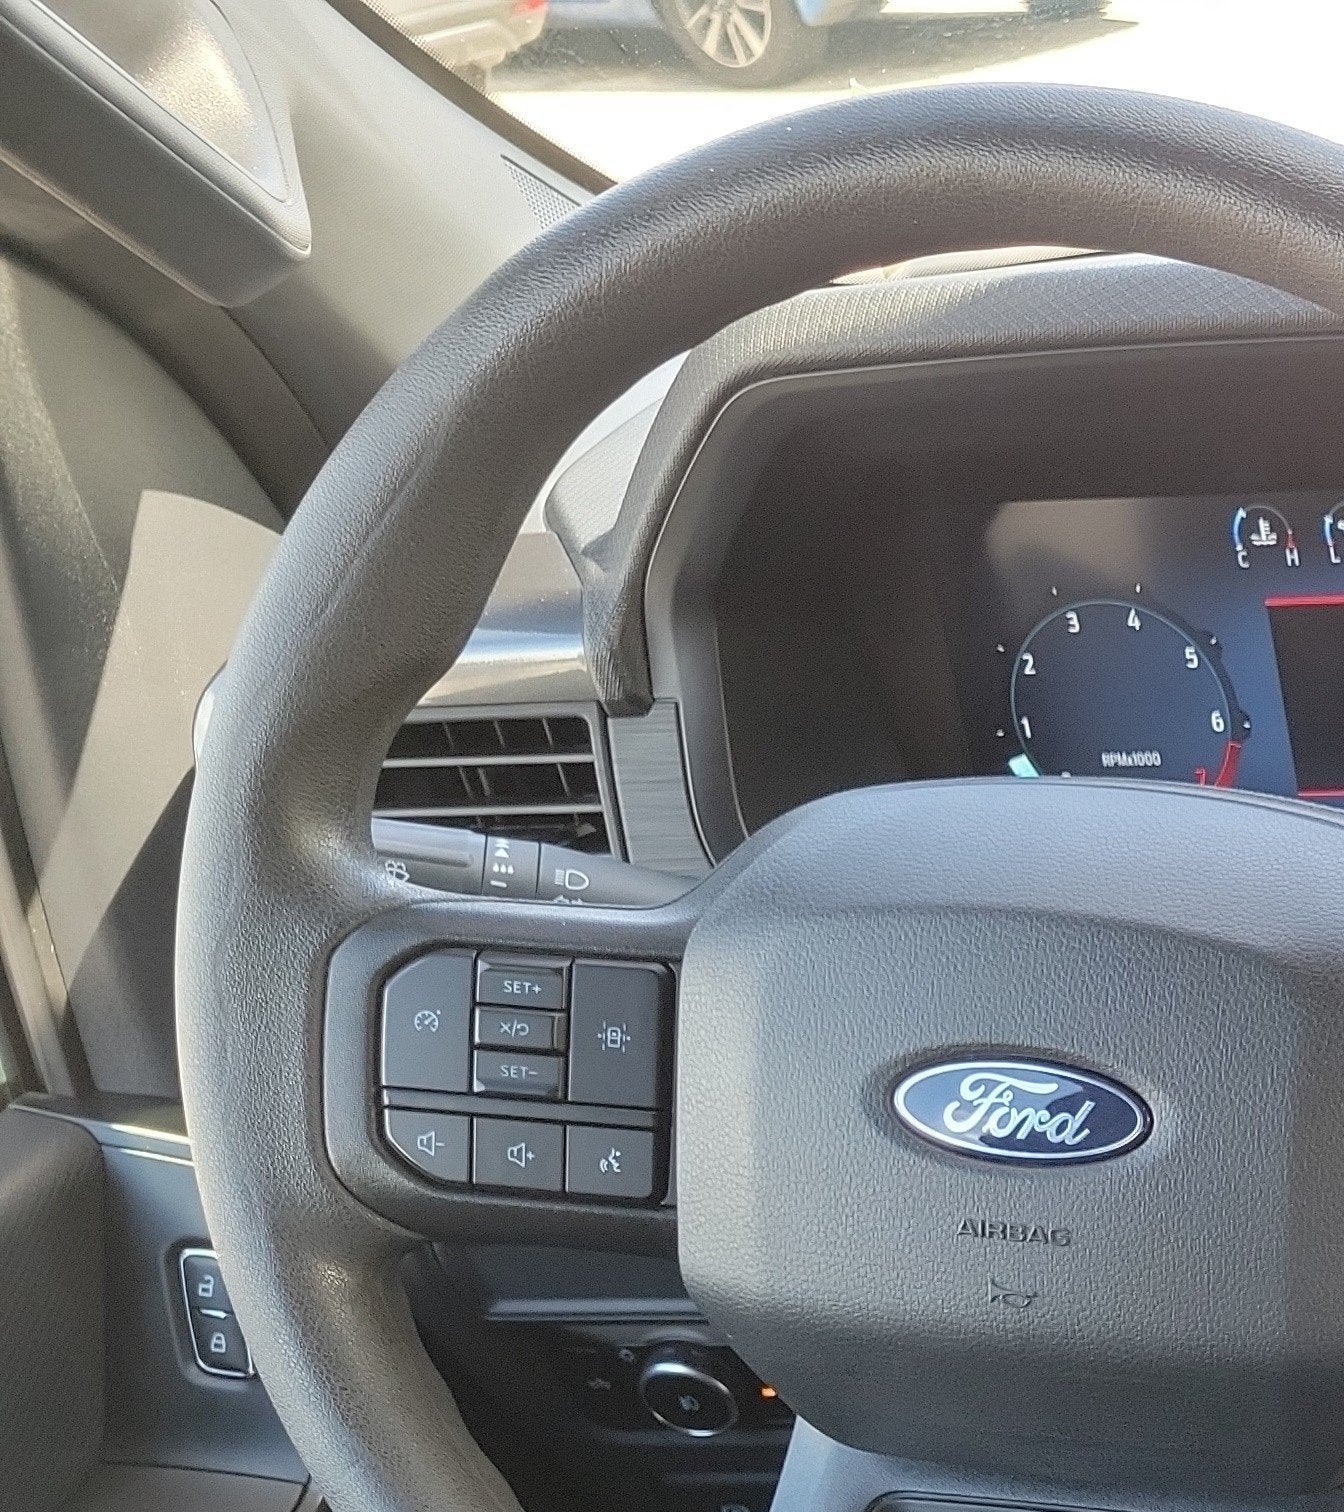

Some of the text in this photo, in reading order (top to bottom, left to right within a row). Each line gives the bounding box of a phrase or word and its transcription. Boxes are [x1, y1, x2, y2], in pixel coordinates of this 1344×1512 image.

[1237, 549, 1250, 569] C
[1285, 547, 1300, 568] H
[1329, 546, 1342, 564] L
[1065, 610, 1081, 634] 3
[1127, 608, 1142, 631] 4
[1021, 652, 1036, 676] 2
[1184, 646, 1199, 669] 5
[1020, 716, 1032, 739] 1
[1211, 710, 1225, 733] 6
[943, 1072, 1096, 1146] Ford
[956, 1219, 1073, 1247] AIRBAG
